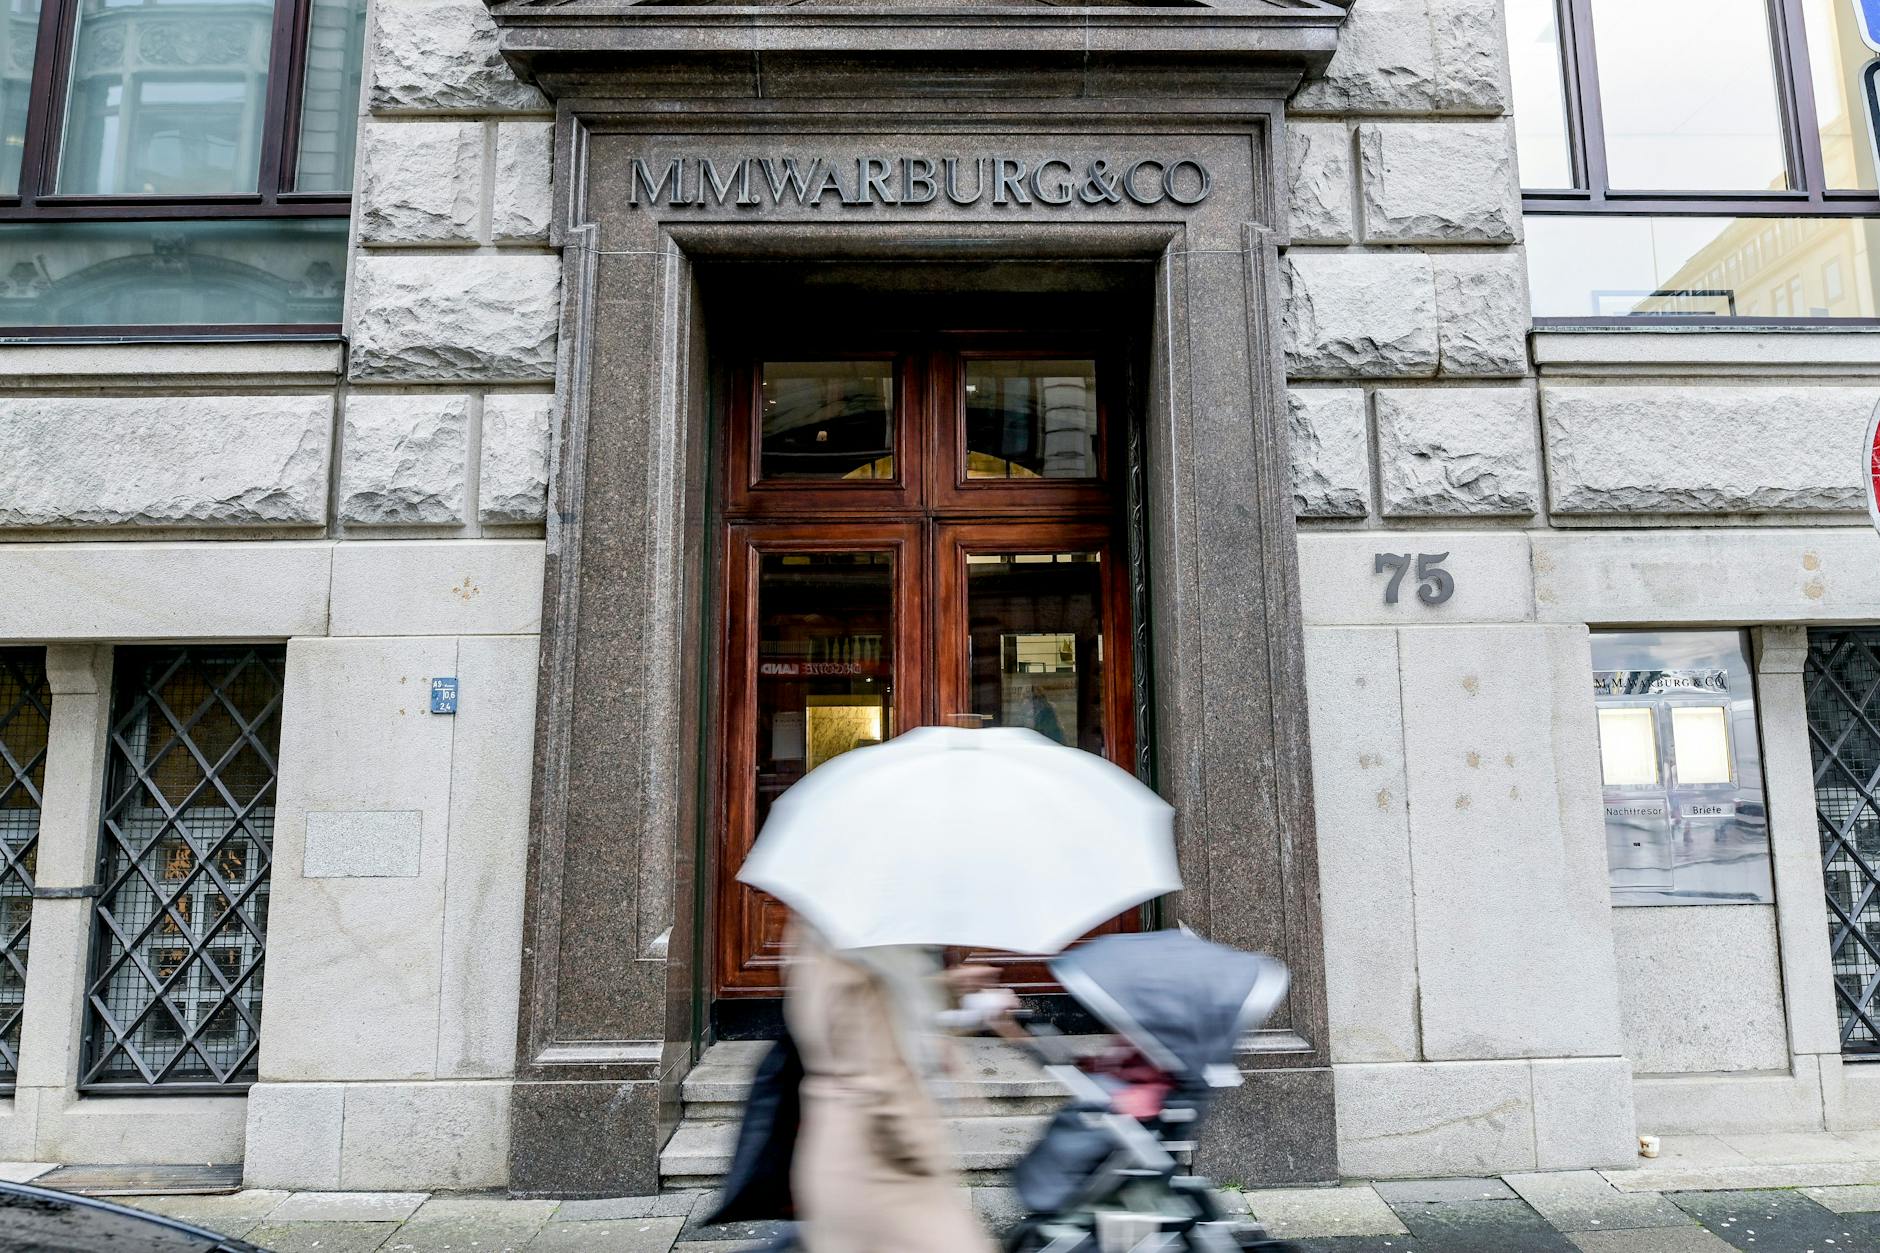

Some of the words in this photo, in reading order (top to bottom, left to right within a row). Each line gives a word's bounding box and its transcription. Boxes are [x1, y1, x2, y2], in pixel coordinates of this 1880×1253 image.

[1374, 552, 1455, 604] 75
[1606, 807, 1663, 816] Nachttresor
[1692, 806, 1722, 815] Briefe
